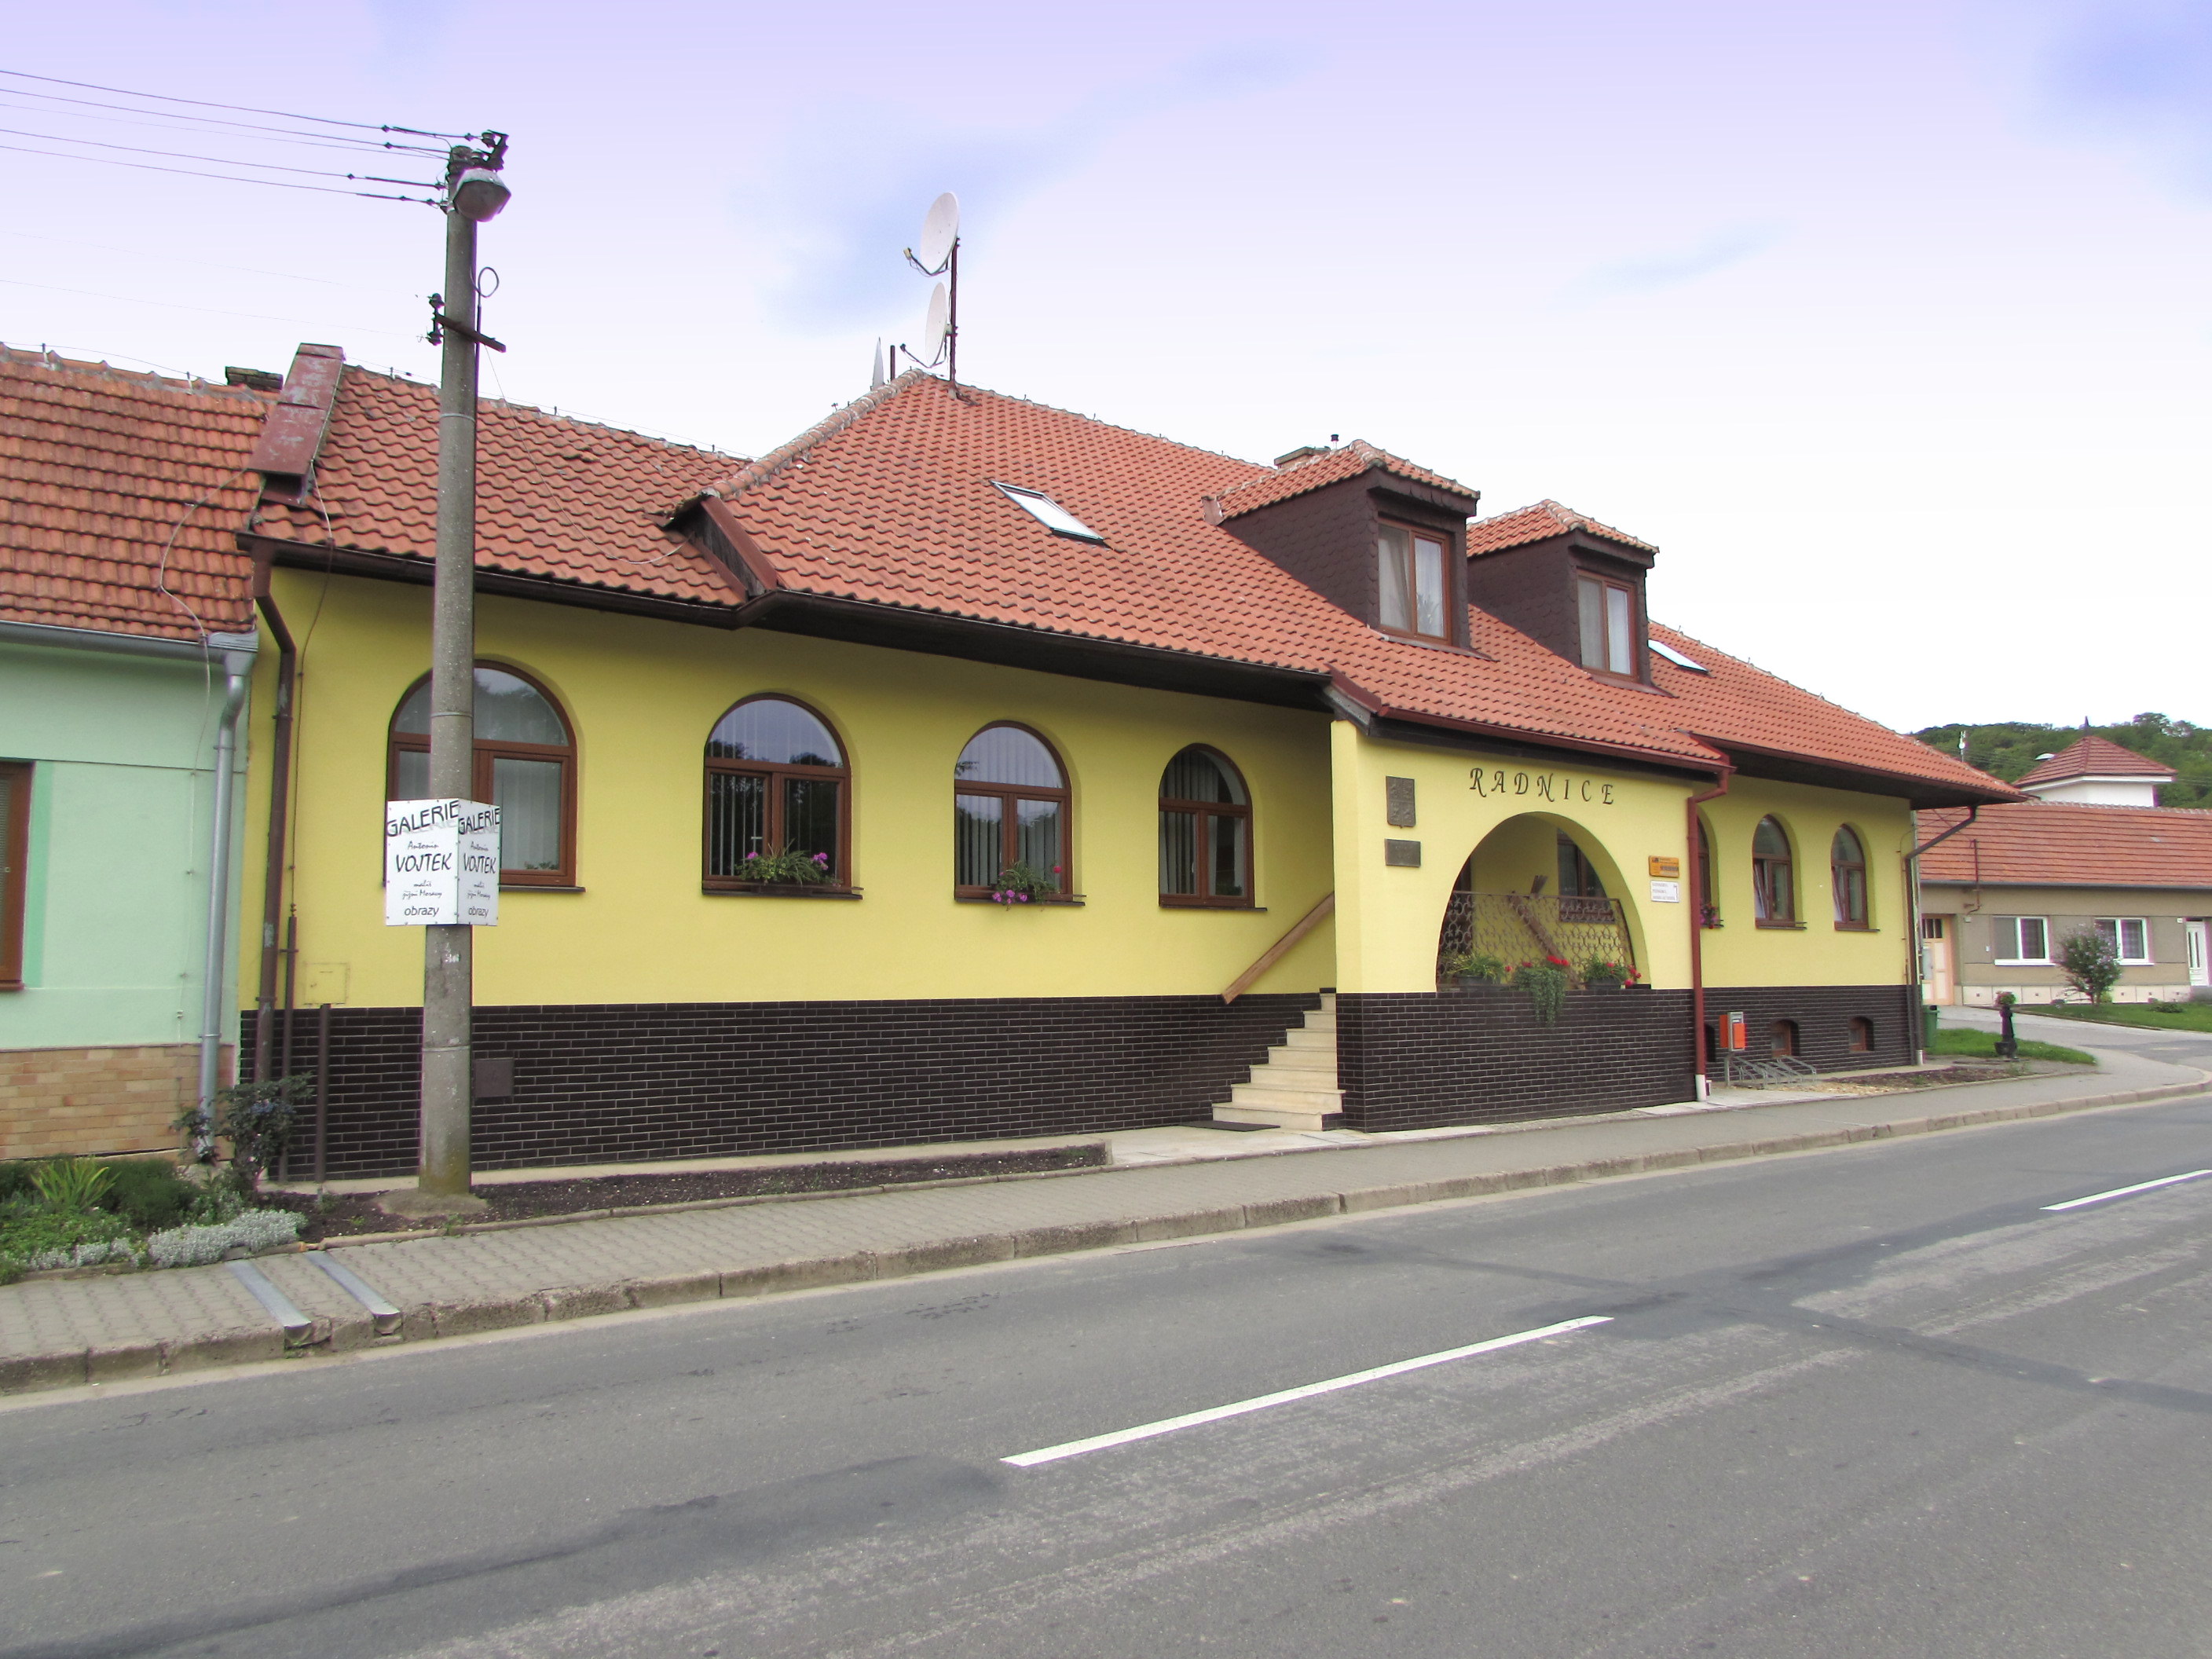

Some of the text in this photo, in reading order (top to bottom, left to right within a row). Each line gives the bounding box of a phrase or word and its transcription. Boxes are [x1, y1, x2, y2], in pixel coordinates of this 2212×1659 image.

[1469, 767, 1614, 805] RADNICE
[387, 800, 459, 837] GALERIE
[459, 808, 500, 835] GALERIE
[396, 853, 452, 873] VOJTEK
[463, 853, 496, 874] VOJTEK
[404, 906, 439, 917] obrazy
[468, 906, 489, 917] obrazy
